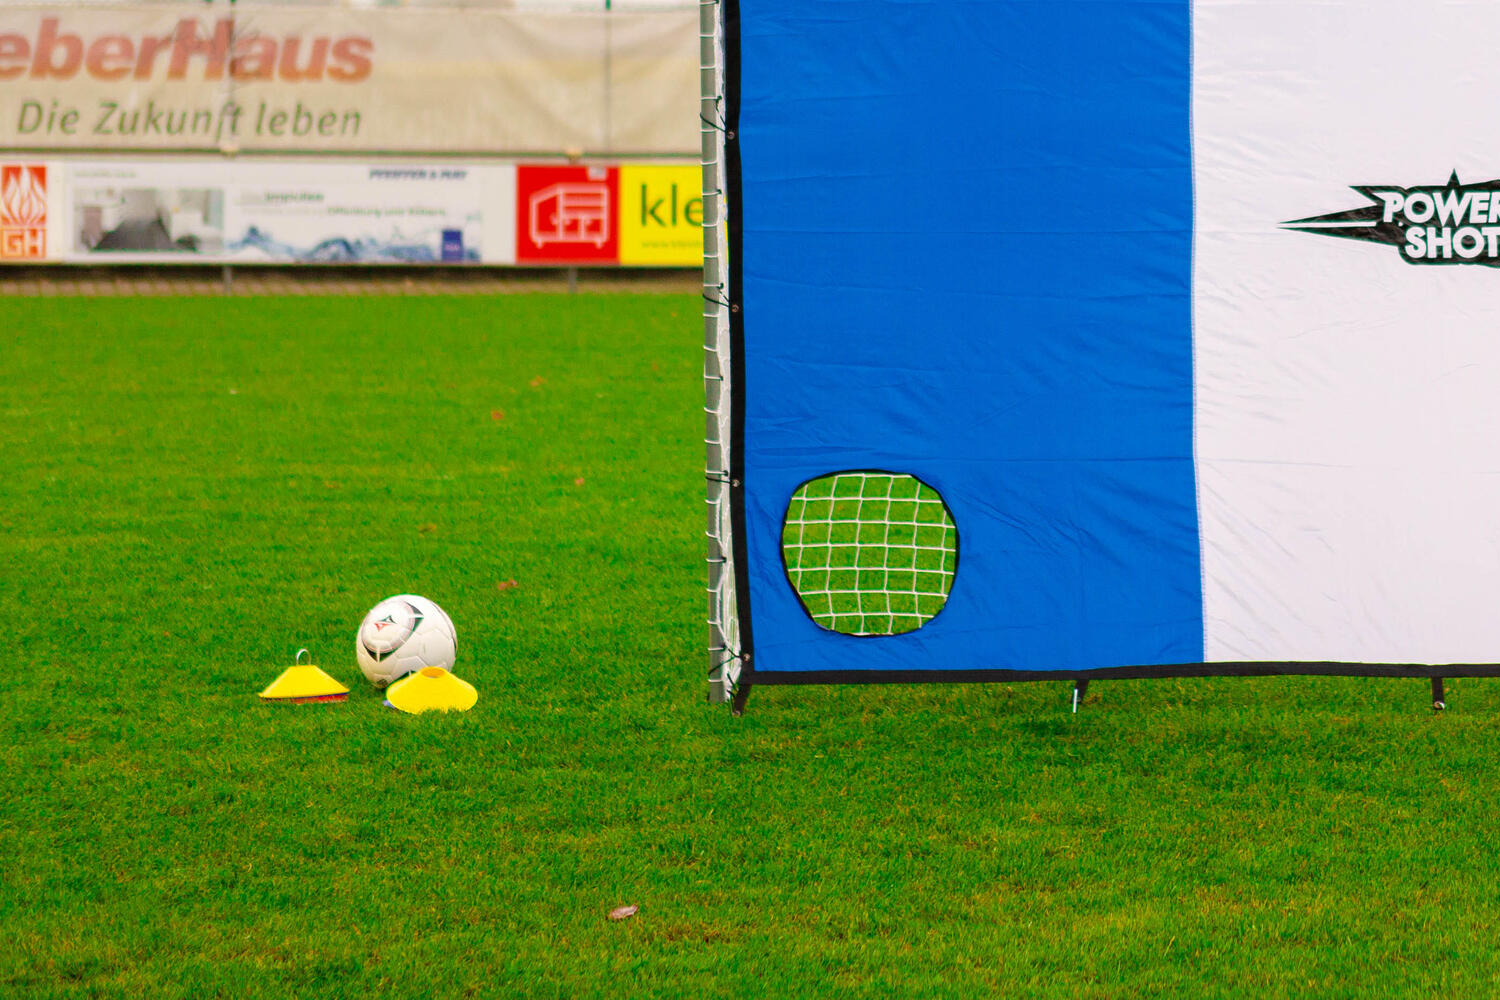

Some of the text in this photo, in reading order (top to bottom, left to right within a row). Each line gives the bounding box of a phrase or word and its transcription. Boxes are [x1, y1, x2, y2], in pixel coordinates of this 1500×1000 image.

[17, 101, 361, 143] Die Zukunft leben
